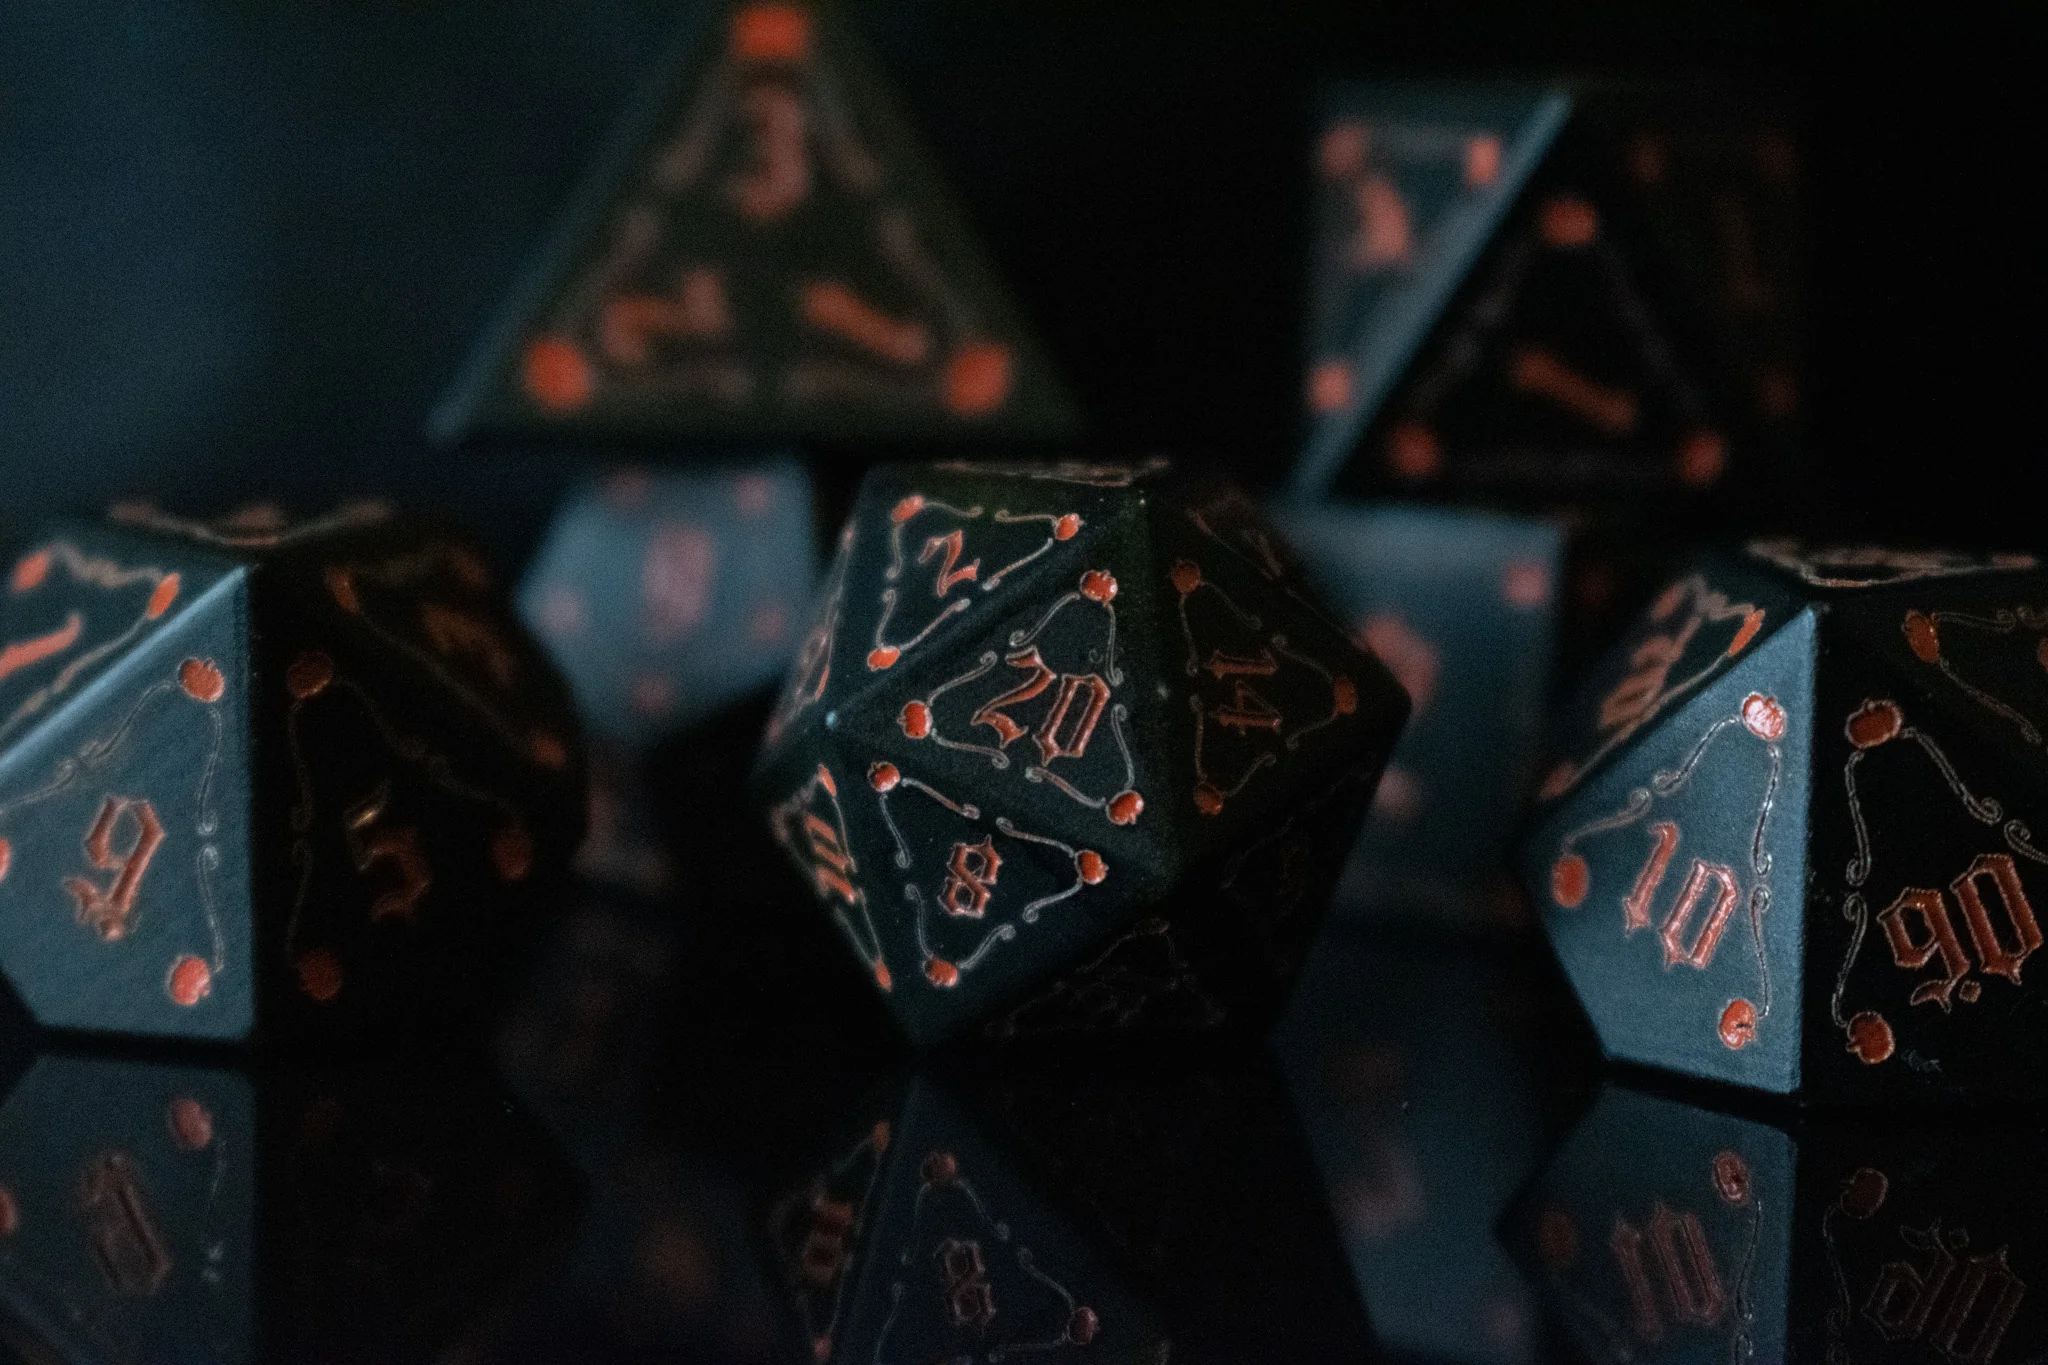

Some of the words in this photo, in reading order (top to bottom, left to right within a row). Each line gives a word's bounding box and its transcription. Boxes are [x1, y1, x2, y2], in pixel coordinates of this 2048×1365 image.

[918, 528, 982, 598] 2
[971, 644, 1112, 766] 20
[1204, 649, 1284, 737] 14
[63, 793, 168, 943] 9
[937, 834, 1003, 919] 8
[1621, 820, 1742, 971] 10
[1876, 853, 2045, 1013] 90
